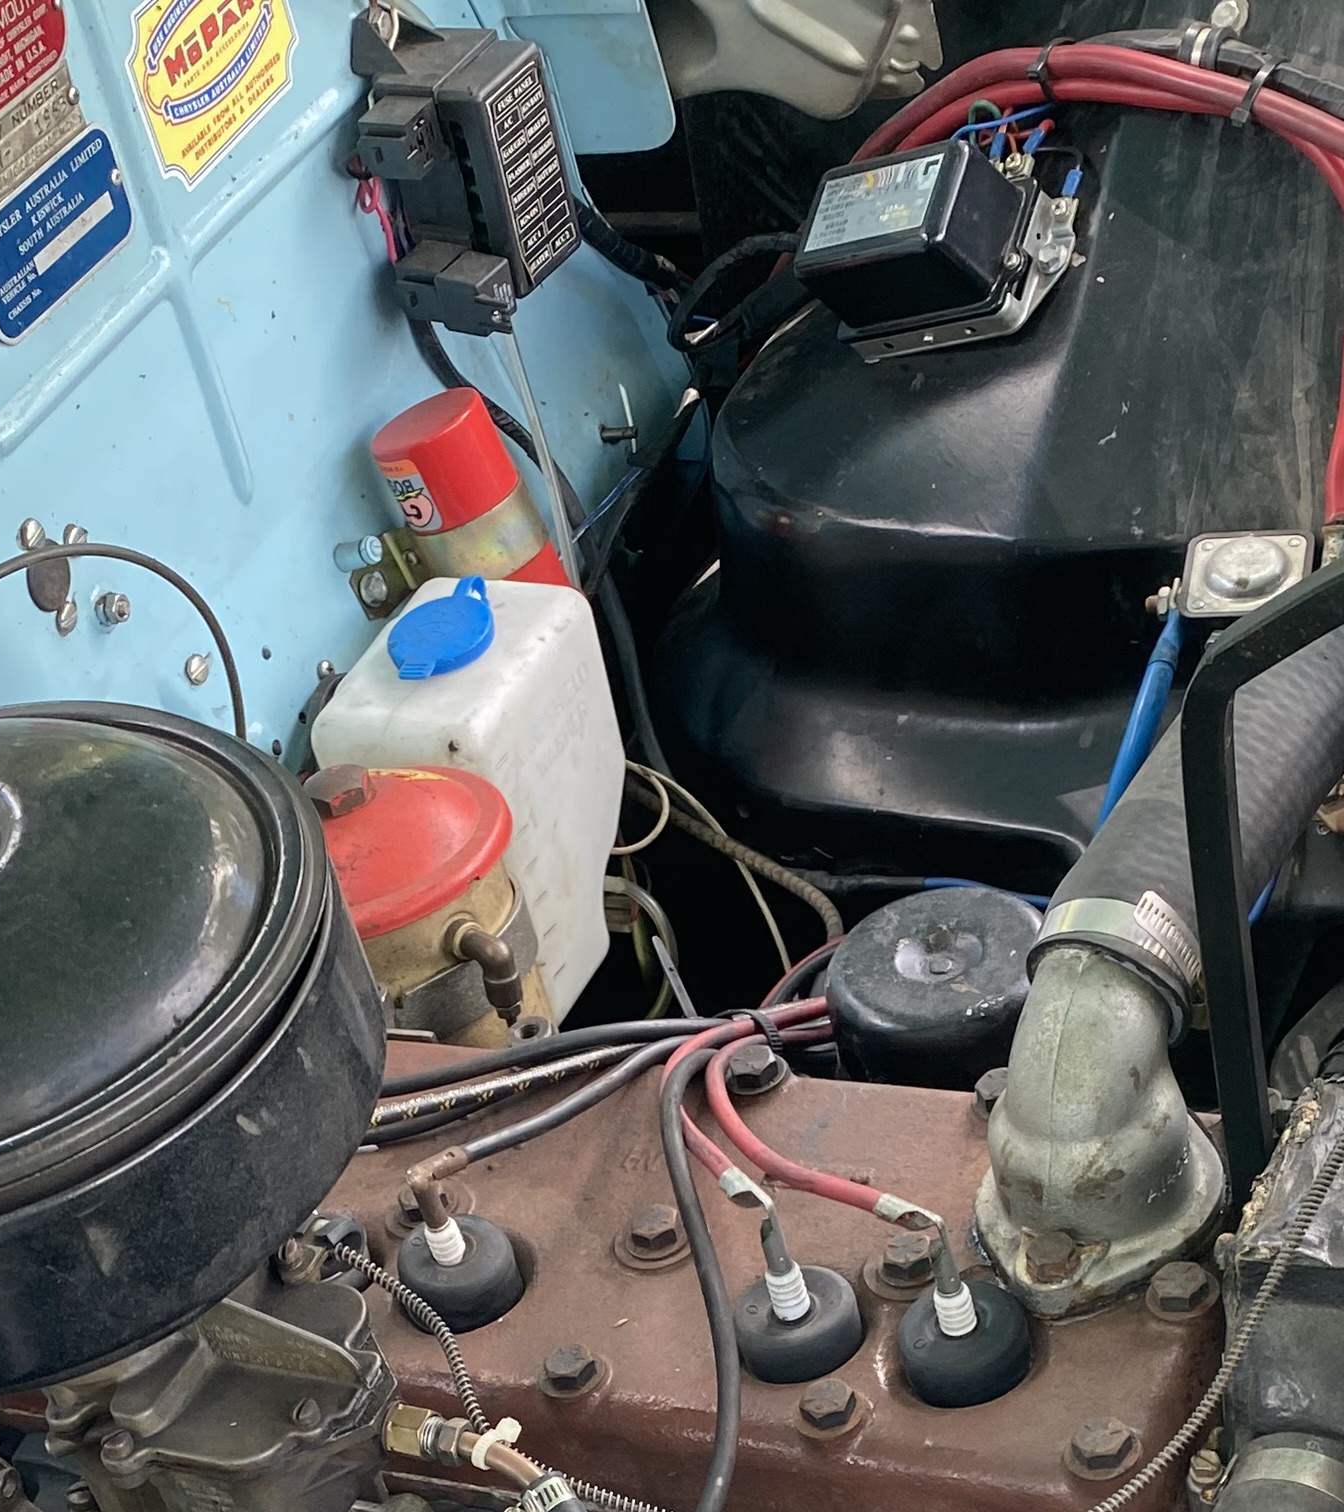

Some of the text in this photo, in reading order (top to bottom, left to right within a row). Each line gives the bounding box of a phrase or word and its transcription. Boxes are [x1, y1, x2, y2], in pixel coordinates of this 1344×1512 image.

[15, 57, 26, 73] IN
[173, 20, 267, 118] CHRYSLER AUSTRALIA LIMITED
[10, 78, 60, 127] NUMBER
[497, 76, 534, 113] FUSE PANEL
[181, 124, 211, 159] AVAILABLE
[212, 104, 230, 126] FROM
[231, 92, 244, 108] ALL
[195, 115, 237, 161] DISTRIBUTORS
[247, 75, 274, 106] DEALERS
[25, 170, 69, 214] AUSTRALIA
[70, 138, 103, 172] LIMITED
[18, 228, 44, 256] SOUTH
[46, 192, 85, 232] AUSTRALIA
[30, 191, 65, 227] KESWICK
[0, 260, 36, 297] AUSTRALIAN
[1, 278, 27, 305] VEHICLE
[7, 295, 33, 320] CHASSIS
